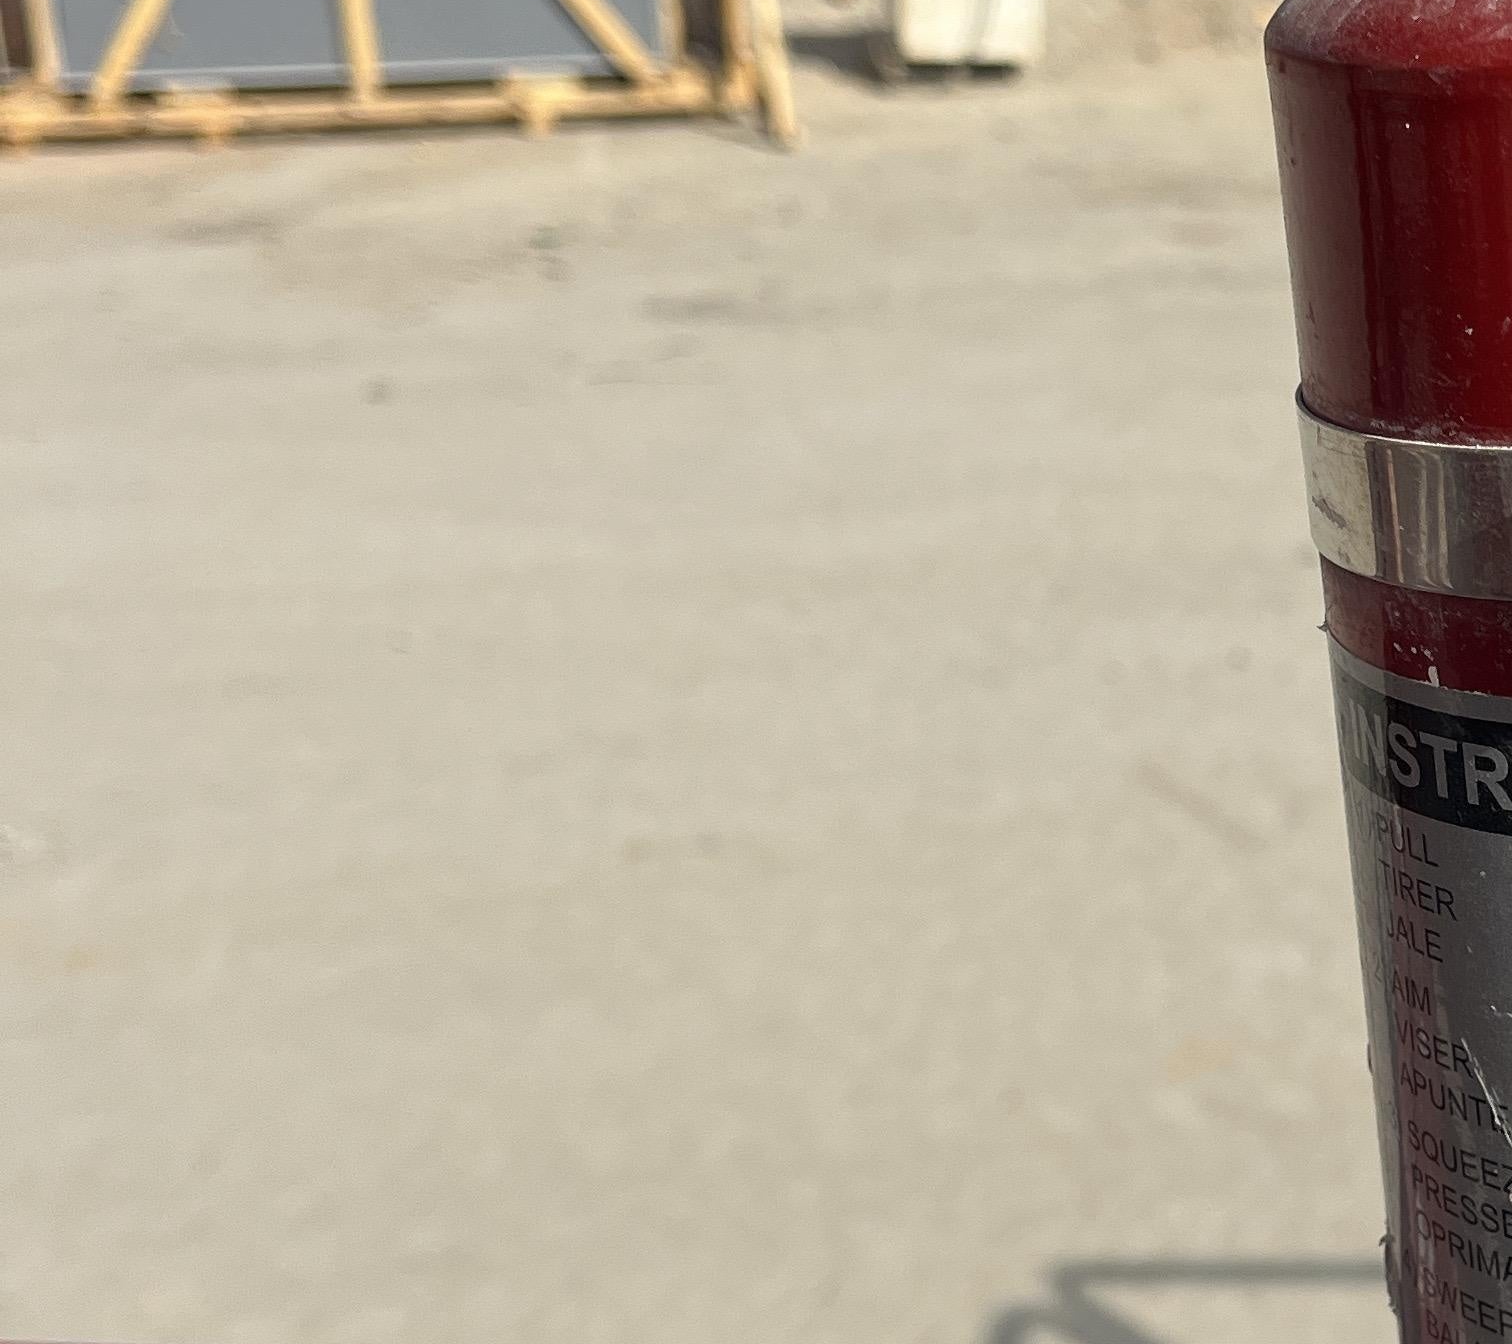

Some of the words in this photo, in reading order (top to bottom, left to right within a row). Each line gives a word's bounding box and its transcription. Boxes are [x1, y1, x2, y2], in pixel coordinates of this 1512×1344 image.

[1377, 811, 1441, 868] PULL
[1379, 857, 1459, 922] TIRER
[1386, 916, 1445, 965] JALE
[1392, 970, 1433, 1017] AIM
[1398, 1024, 1474, 1080] VISER
